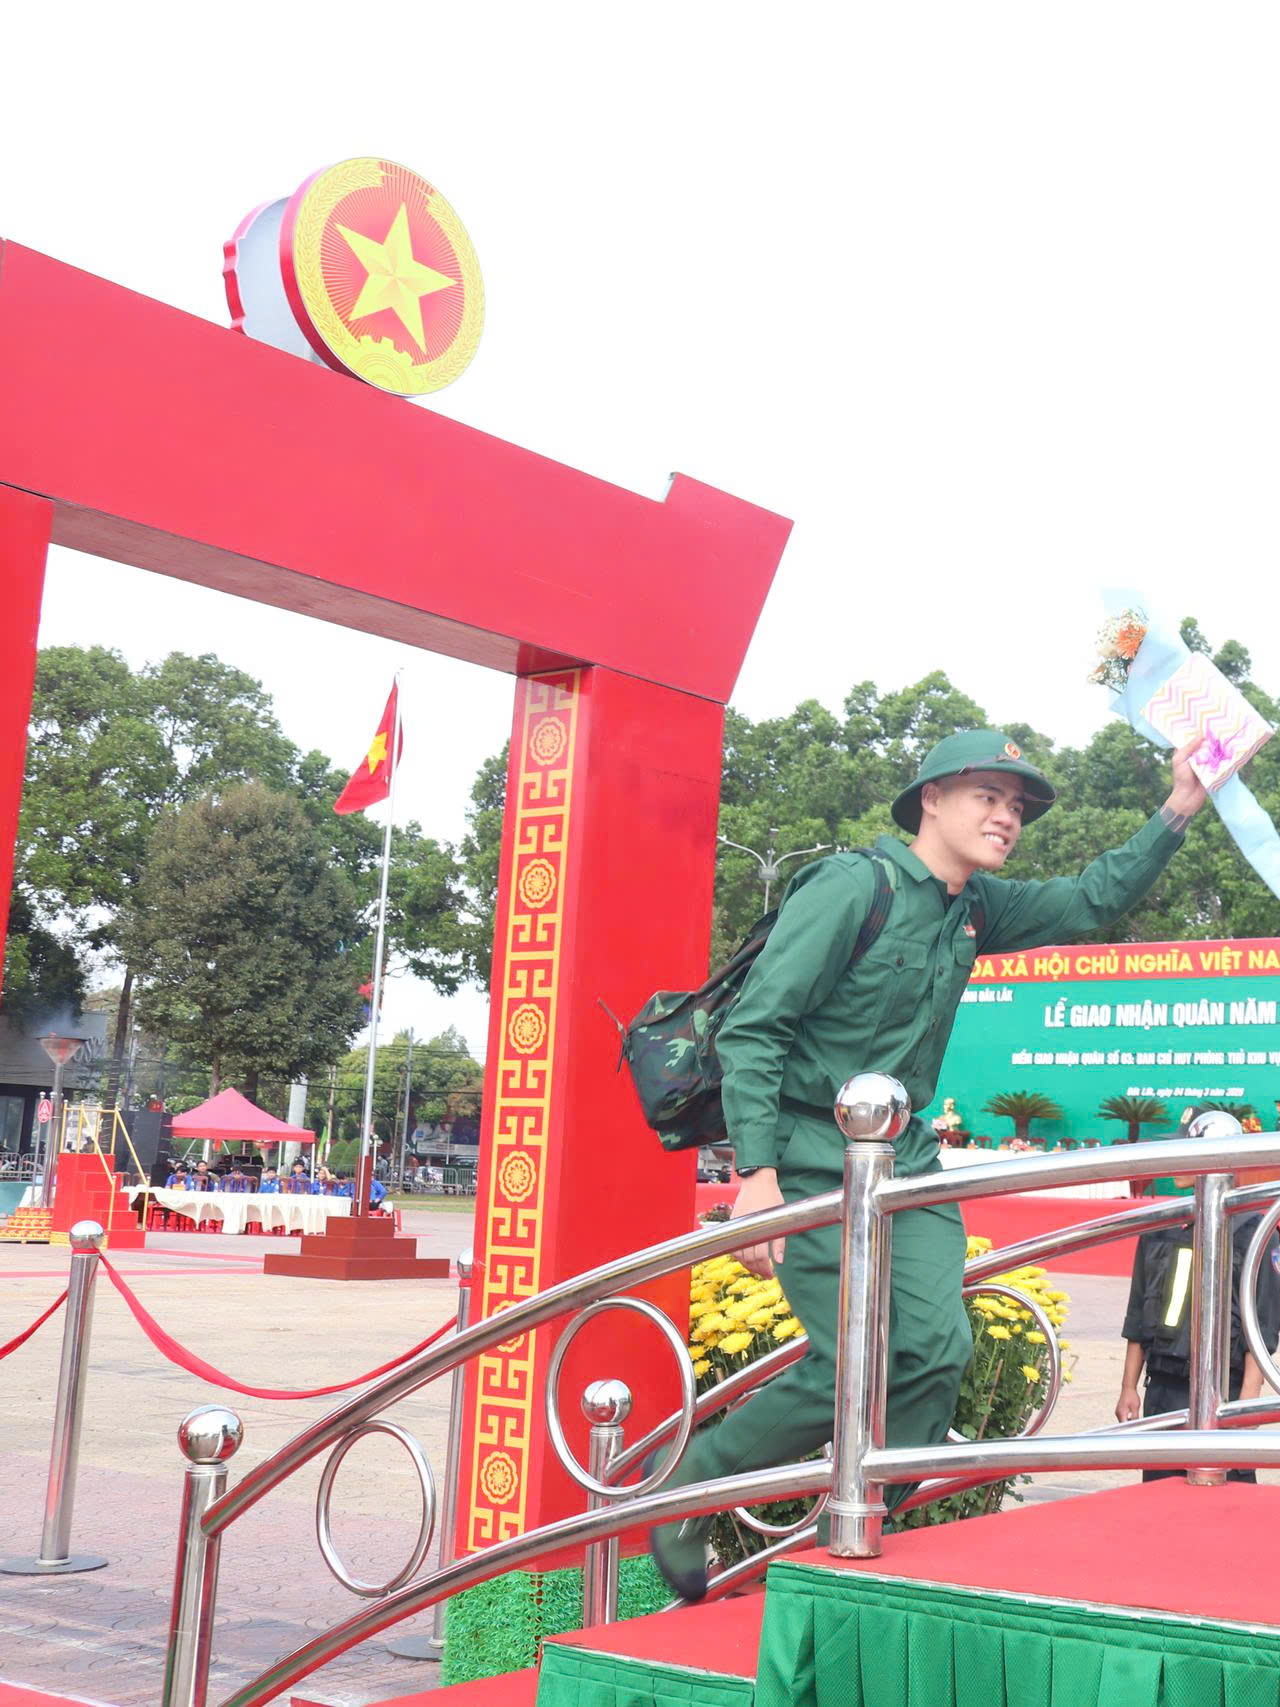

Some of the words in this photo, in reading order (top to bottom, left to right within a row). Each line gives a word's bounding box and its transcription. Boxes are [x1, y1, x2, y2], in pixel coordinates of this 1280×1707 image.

[1000, 954, 1029, 977] XÃ
[1034, 952, 1069, 981] HỘI
[1075, 949, 1119, 975] CHỦ
[1125, 948, 1193, 974] NGHĨA
[1199, 946, 1243, 976] VIỆT
[1044, 996, 1068, 1028] LỄ
[1069, 1004, 1112, 1028] GIAO
[1115, 1000, 1169, 1031] NHẬN
[1172, 999, 1225, 1029] QUÂN
[1229, 997, 1277, 1025] NĂM
